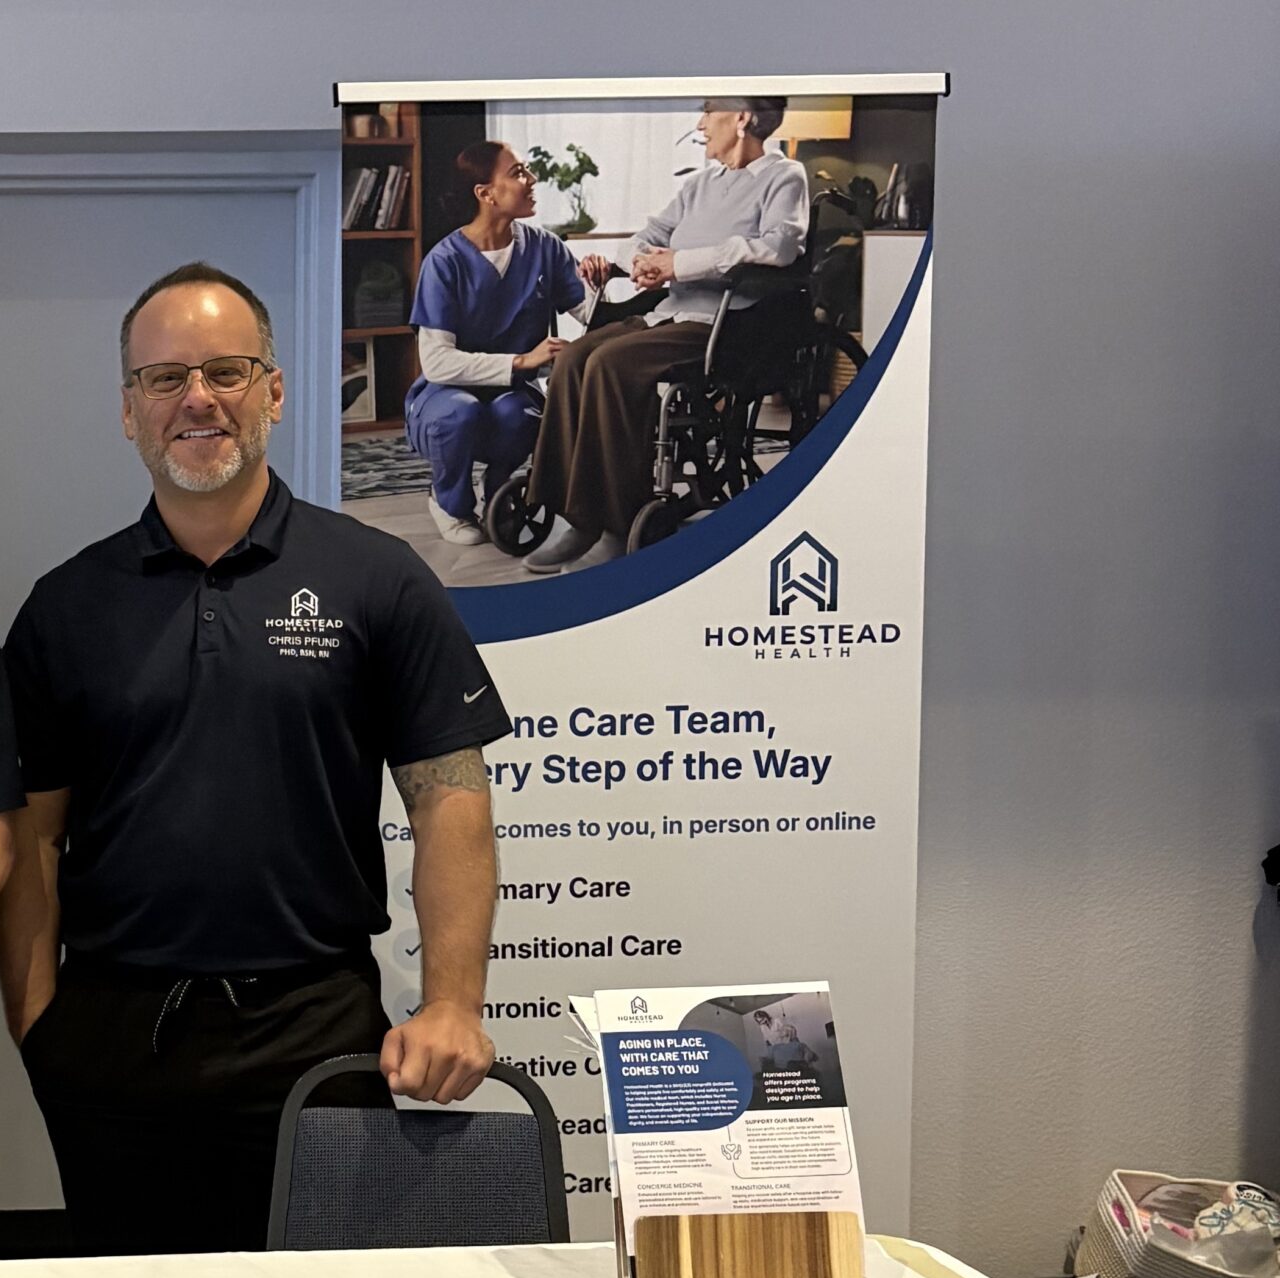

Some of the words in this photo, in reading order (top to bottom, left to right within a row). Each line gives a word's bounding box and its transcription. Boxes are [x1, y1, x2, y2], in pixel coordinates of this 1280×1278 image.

[265, 617, 343, 628] HOMESTEAD
[268, 636, 302, 645] CHRIS
[304, 636, 340, 647] PFUND
[704, 624, 901, 647] HOMESTEAD
[755, 647, 851, 659] HEALTH
[514, 715, 558, 738] ne
[569, 706, 654, 737] Care
[666, 704, 776, 740] Team,
[542, 753, 626, 789] Step
[637, 750, 673, 782] of
[686, 750, 742, 781] the
[754, 748, 832, 785] Way
[380, 822, 412, 842] Ca
[495, 822, 571, 839] comes
[577, 818, 601, 837] to
[607, 818, 656, 841] you,
[662, 815, 682, 835] in
[688, 816, 771, 841] person
[776, 815, 799, 833] or
[805, 811, 876, 831] online
[497, 881, 561, 904] mary
[569, 877, 631, 899] Care
[487, 935, 613, 959] ansitional
[620, 935, 681, 957] Care
[619, 1040, 652, 1050] AGING
[654, 1038, 664, 1049] IN
[620, 1053, 648, 1063] WITH
[650, 1051, 680, 1062] CARE
[681, 1050, 709, 1061] THAT
[622, 1066, 659, 1077] COMES
[661, 1065, 675, 1075] TO
[677, 1064, 699, 1074] YOU
